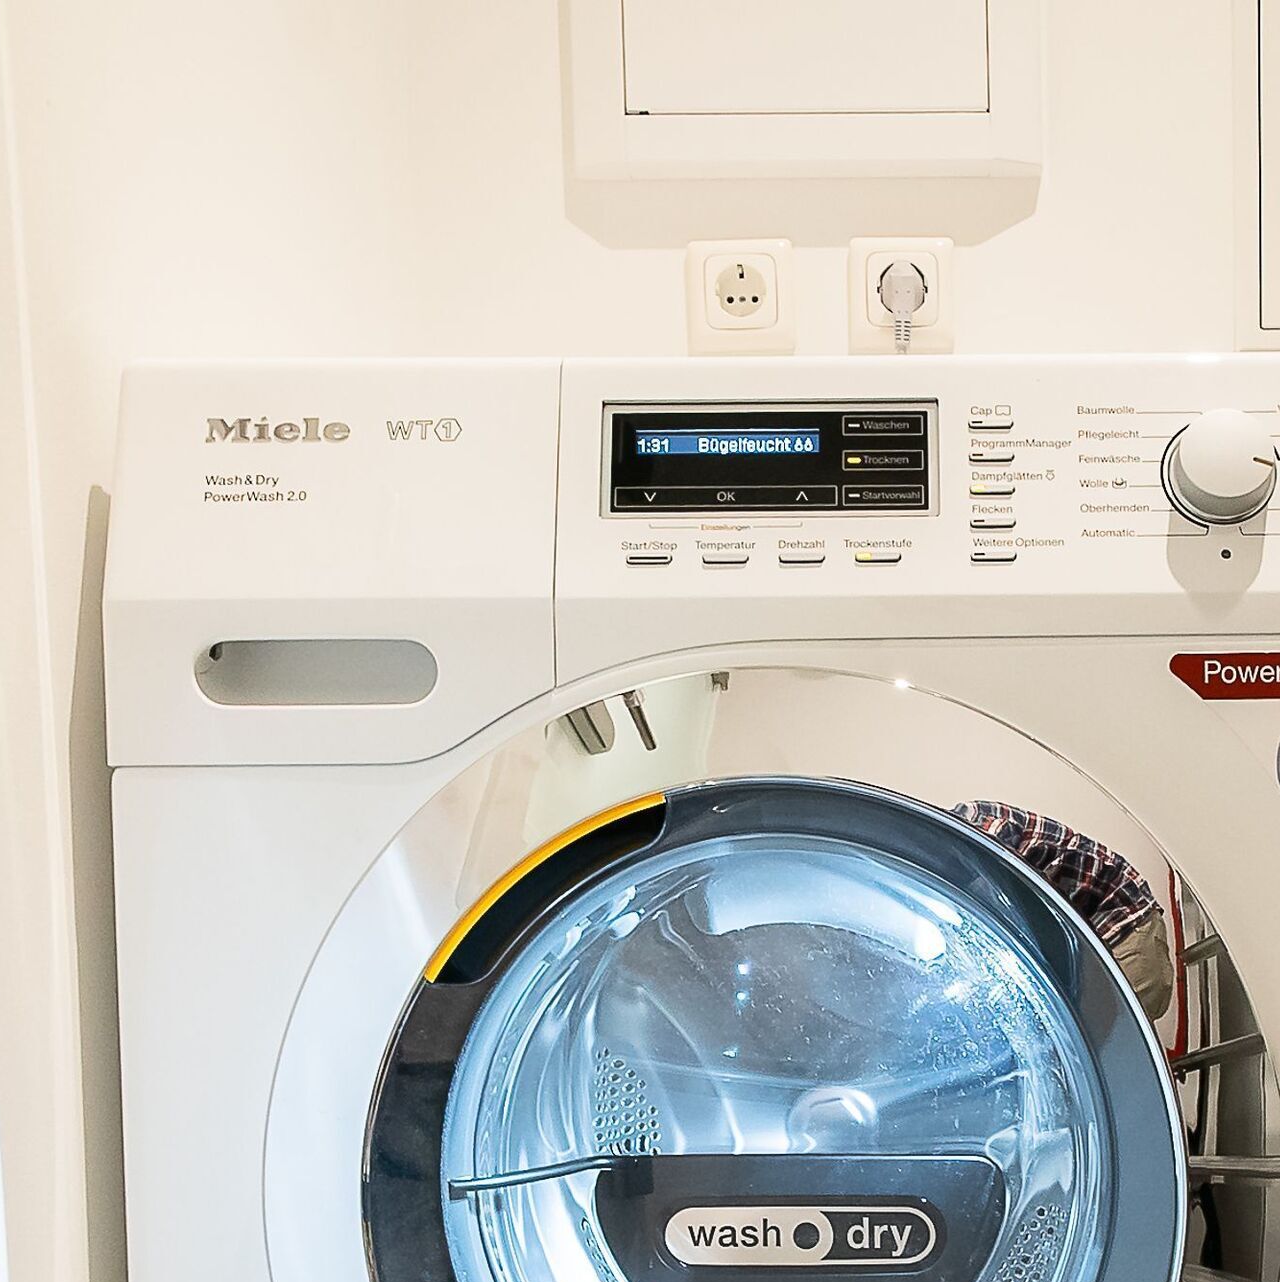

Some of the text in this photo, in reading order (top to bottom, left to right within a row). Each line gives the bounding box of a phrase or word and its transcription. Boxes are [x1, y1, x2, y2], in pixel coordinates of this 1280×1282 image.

[970, 406, 993, 417] Cap
[1077, 405, 1136, 415] Baumwolle
[205, 416, 351, 444] Miele
[862, 420, 910, 430] Waschen
[1078, 429, 1140, 440] Pflegeleicht
[636, 436, 792, 455] 1:31 Bügelfeucht
[970, 438, 1072, 449] ProgrammManager
[863, 455, 910, 464] Trocknen
[1078, 454, 1141, 464] Feinwäsche
[971, 471, 1043, 482] Dampfglätten
[1079, 479, 1109, 489] Wolle
[204, 490, 307, 502] PowerWash 2.0
[716, 490, 736, 502] OK
[862, 490, 921, 500] Startvorwahl
[971, 504, 1013, 514] Flecken
[1080, 503, 1150, 513] Oberhemden
[1081, 528, 1136, 538] Automatic
[621, 540, 678, 551] Start/Stop
[695, 540, 756, 551] Temperatur
[778, 539, 825, 550] Drehzahl
[843, 538, 912, 549] Trockenstufe
[972, 537, 1065, 548] Weitere Optionen
[687, 1215, 913, 1257] wash dry
